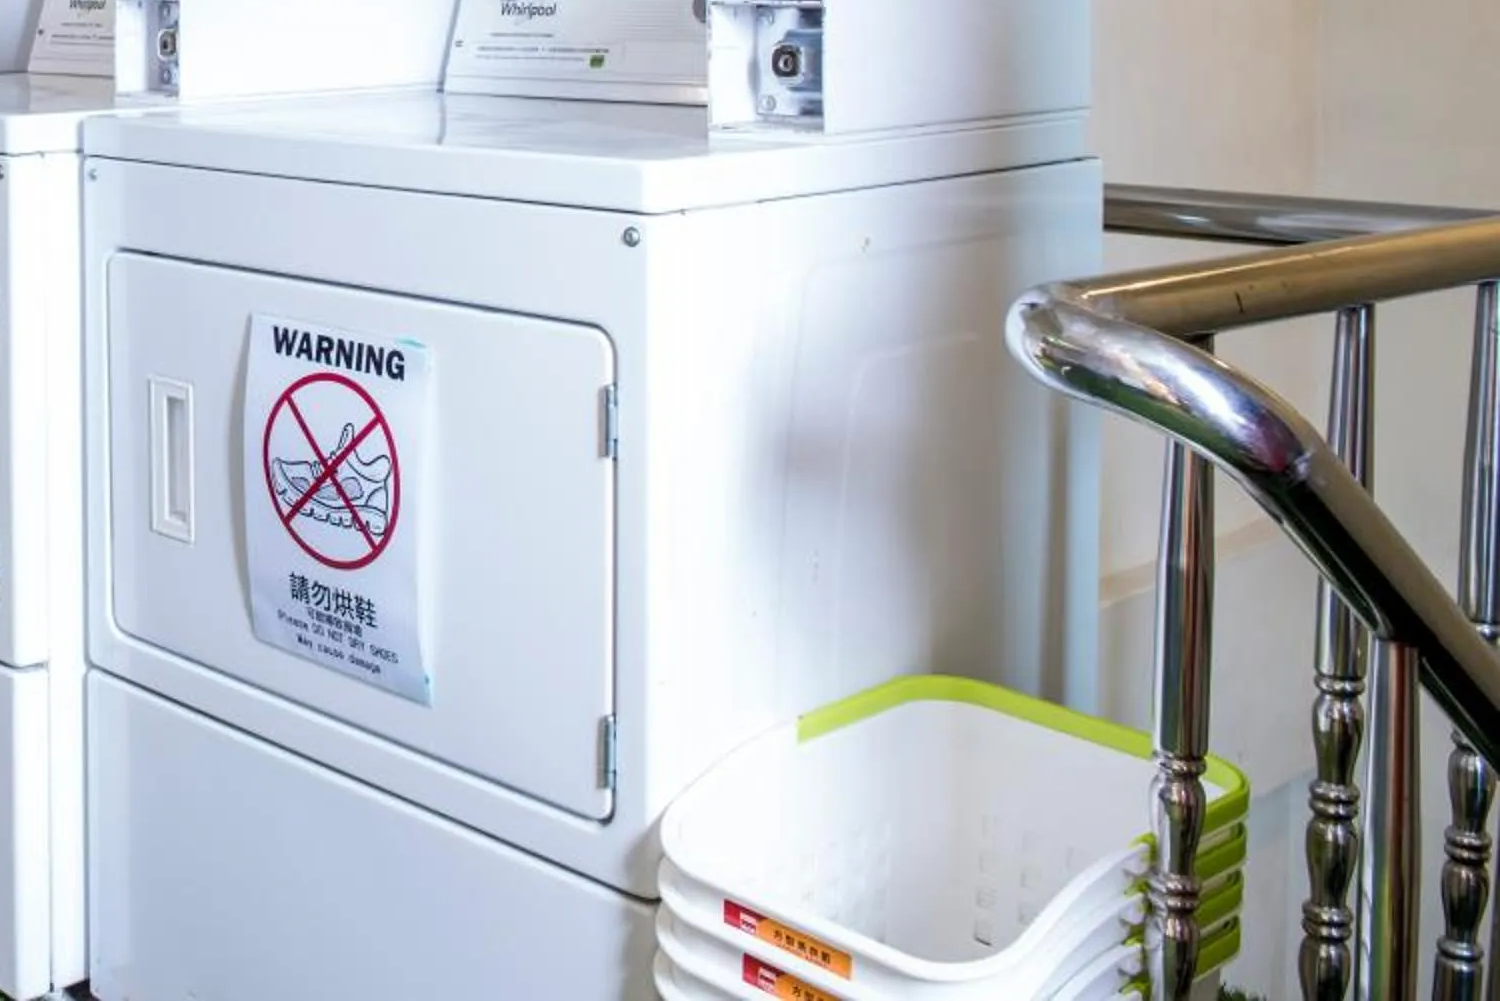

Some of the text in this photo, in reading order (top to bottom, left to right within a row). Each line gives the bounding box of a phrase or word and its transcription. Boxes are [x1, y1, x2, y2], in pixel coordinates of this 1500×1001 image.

[501, 2, 556, 19] Whirlpool
[272, 325, 406, 381] WARNING
[288, 571, 378, 628] 請勿烘鞋
